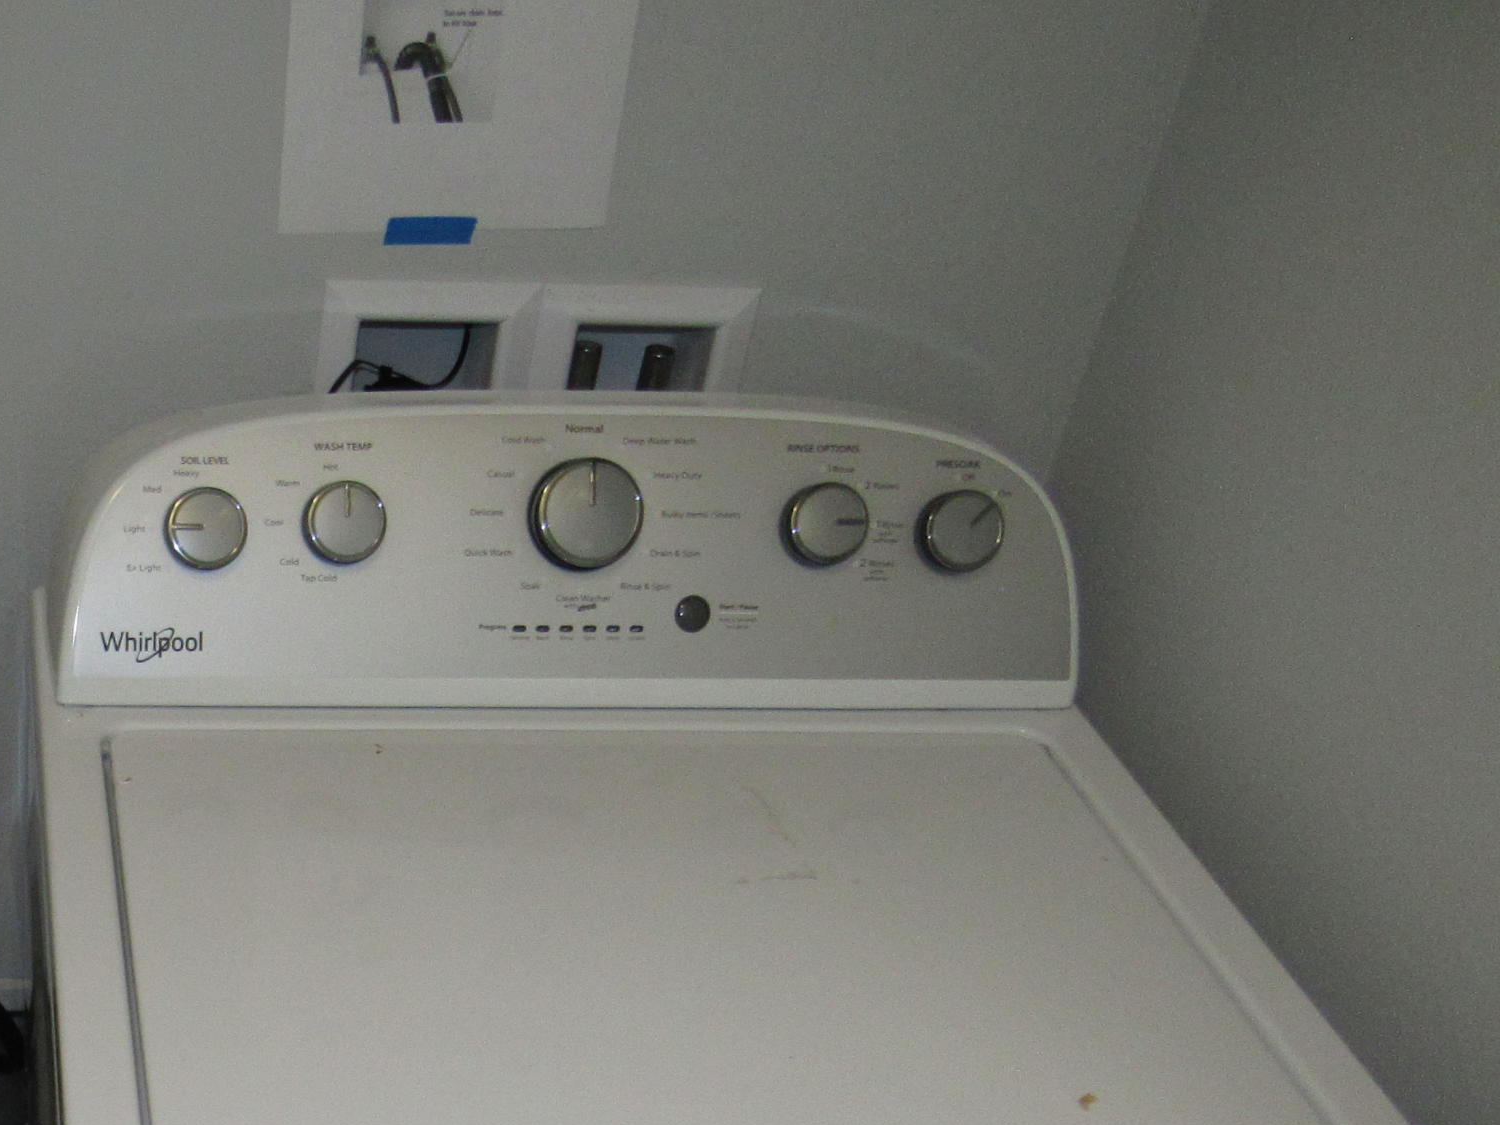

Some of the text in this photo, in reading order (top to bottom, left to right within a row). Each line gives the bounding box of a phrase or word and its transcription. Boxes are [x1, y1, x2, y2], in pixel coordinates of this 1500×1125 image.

[565, 424, 604, 434] Normal
[314, 443, 373, 451] WASH TEMP
[181, 456, 229, 465] SOIL LEVEL
[173, 469, 200, 478] Heavy
[123, 525, 146, 535] Light
[279, 557, 300, 567] Cold
[317, 574, 338, 583] Cold
[100, 628, 204, 662] Whirlpool
